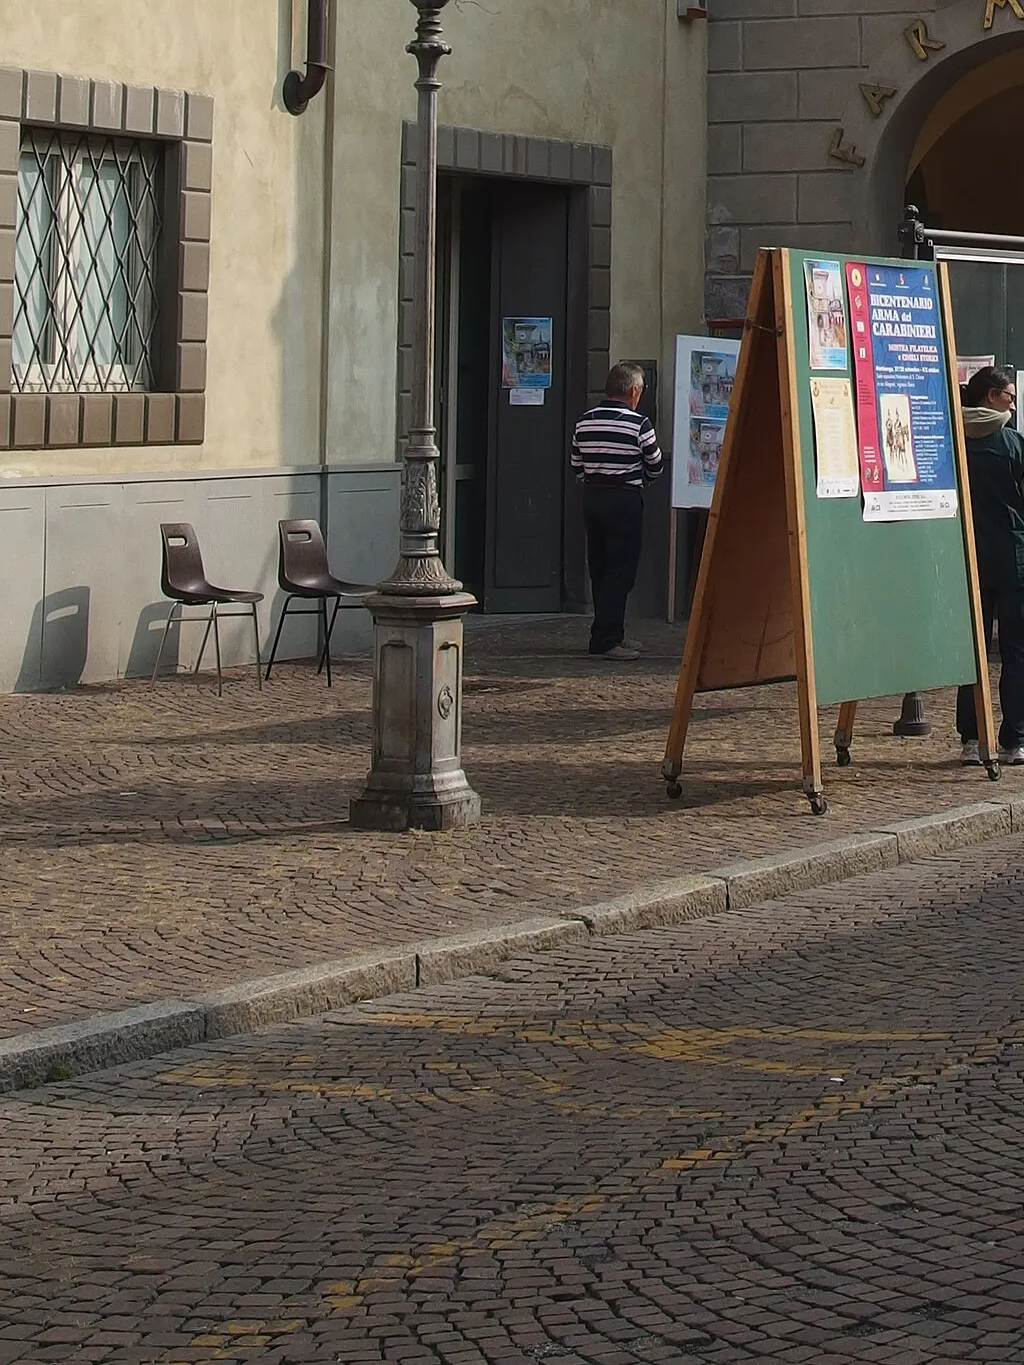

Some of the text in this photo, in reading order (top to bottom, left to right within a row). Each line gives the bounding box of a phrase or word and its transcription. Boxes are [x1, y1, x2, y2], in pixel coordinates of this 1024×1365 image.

[870, 294, 933, 310] BICENTENARIO
[872, 308, 900, 322] ARMA
[872, 322, 936, 338] CARABINIERI
